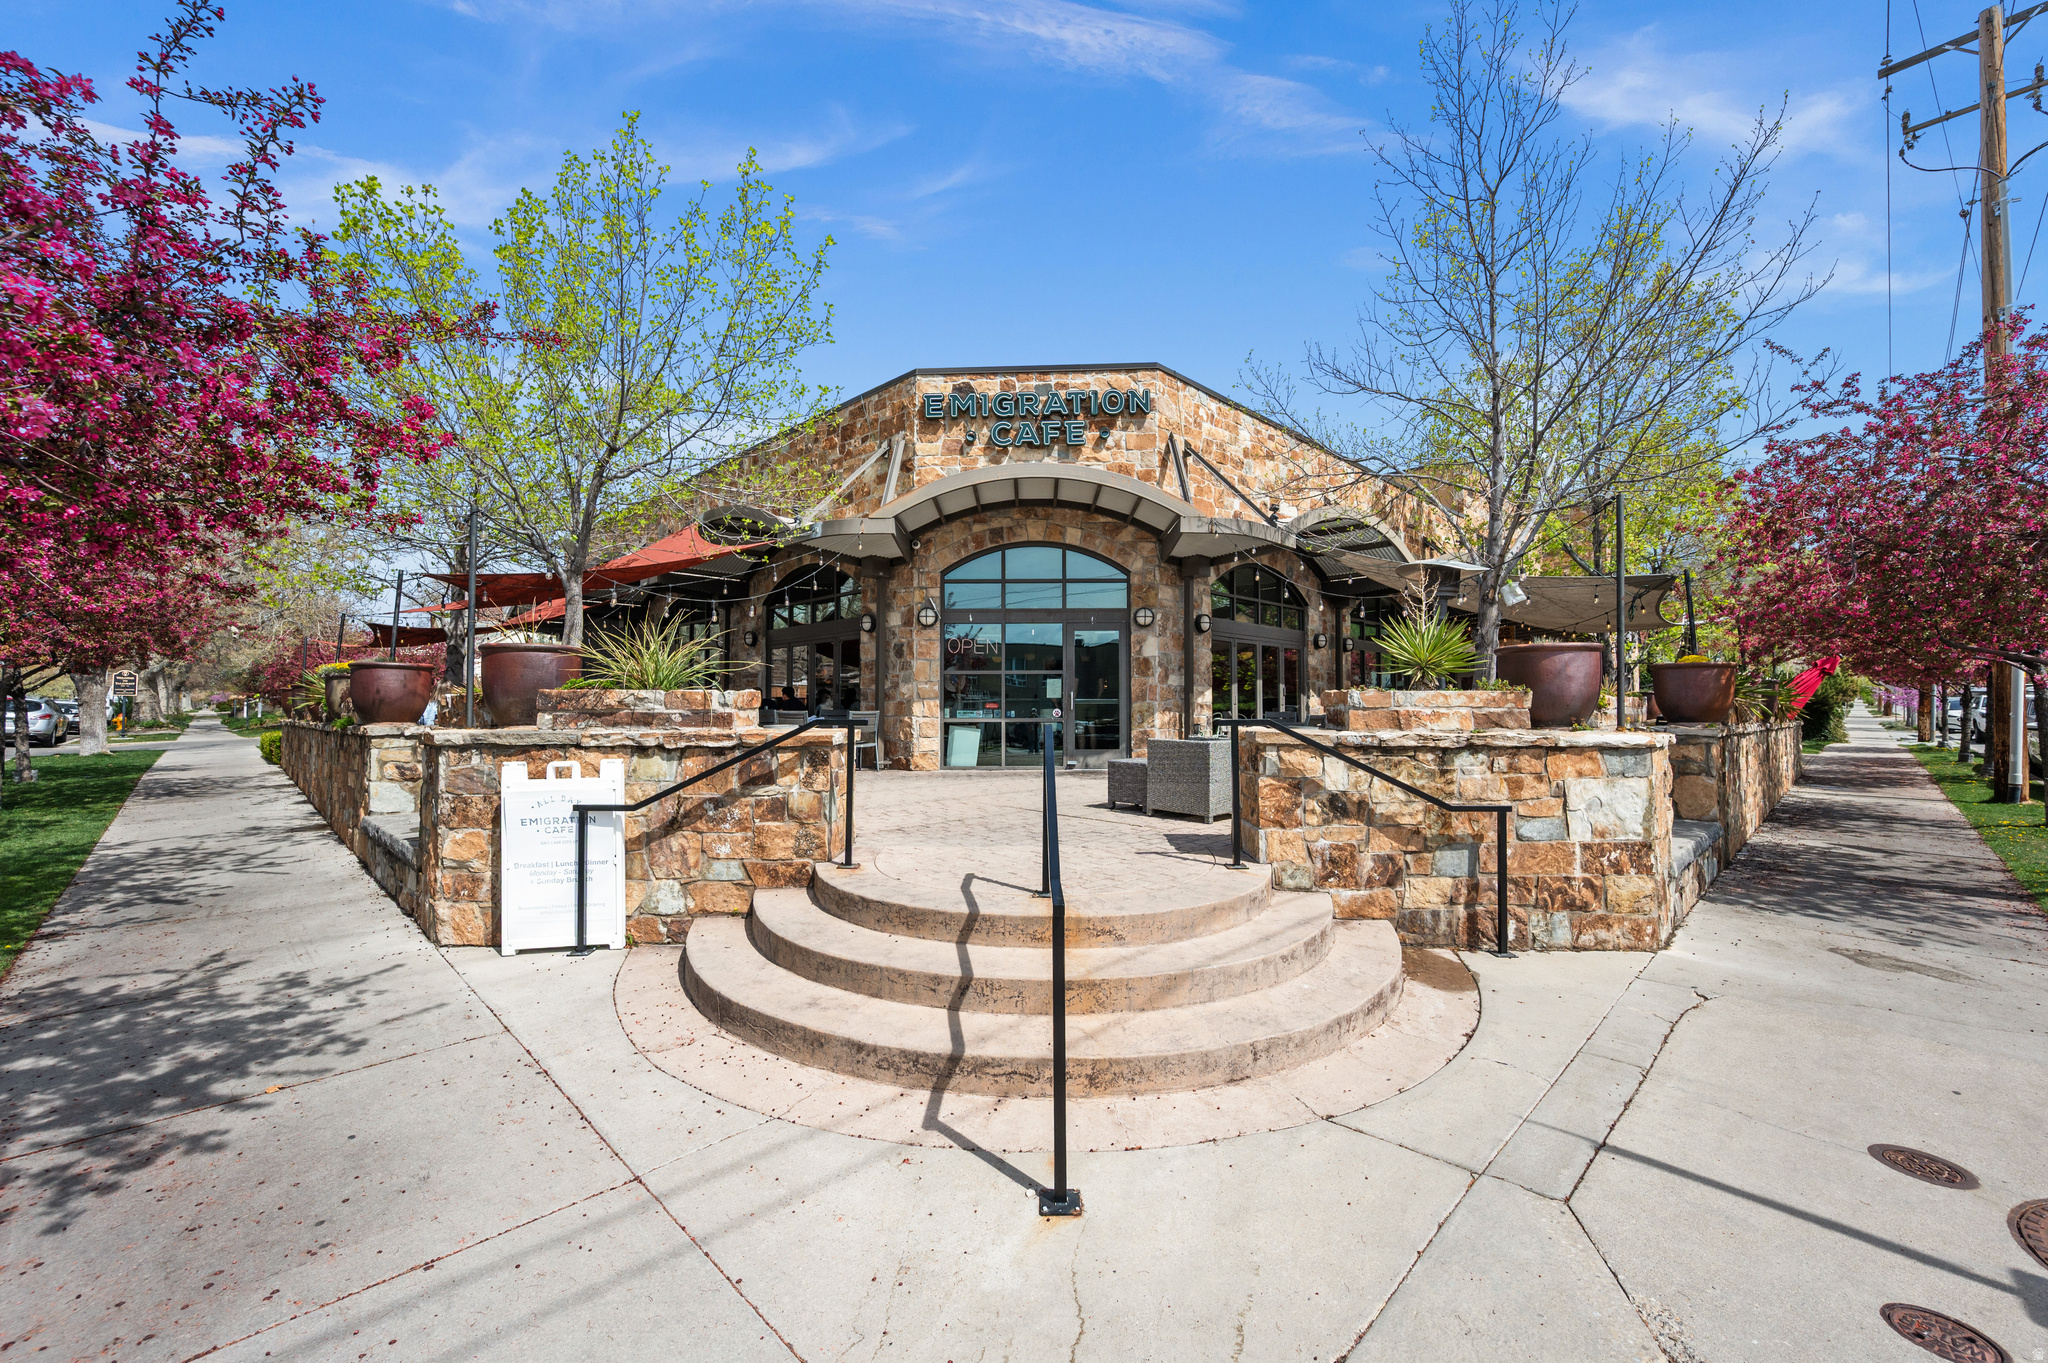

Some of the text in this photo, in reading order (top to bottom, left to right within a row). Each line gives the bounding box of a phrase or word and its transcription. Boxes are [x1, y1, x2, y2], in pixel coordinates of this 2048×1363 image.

[922, 388, 1151, 419] EMIGRATION
[990, 420, 1086, 448] CAFE
[947, 637, 998, 655] OPEN
[537, 794, 582, 808] ALL DAY
[520, 815, 597, 828] EMIGRATIN
[544, 825, 575, 835] CAFE
[514, 861, 549, 870] Breakfast
[529, 870, 557, 878] Monday
